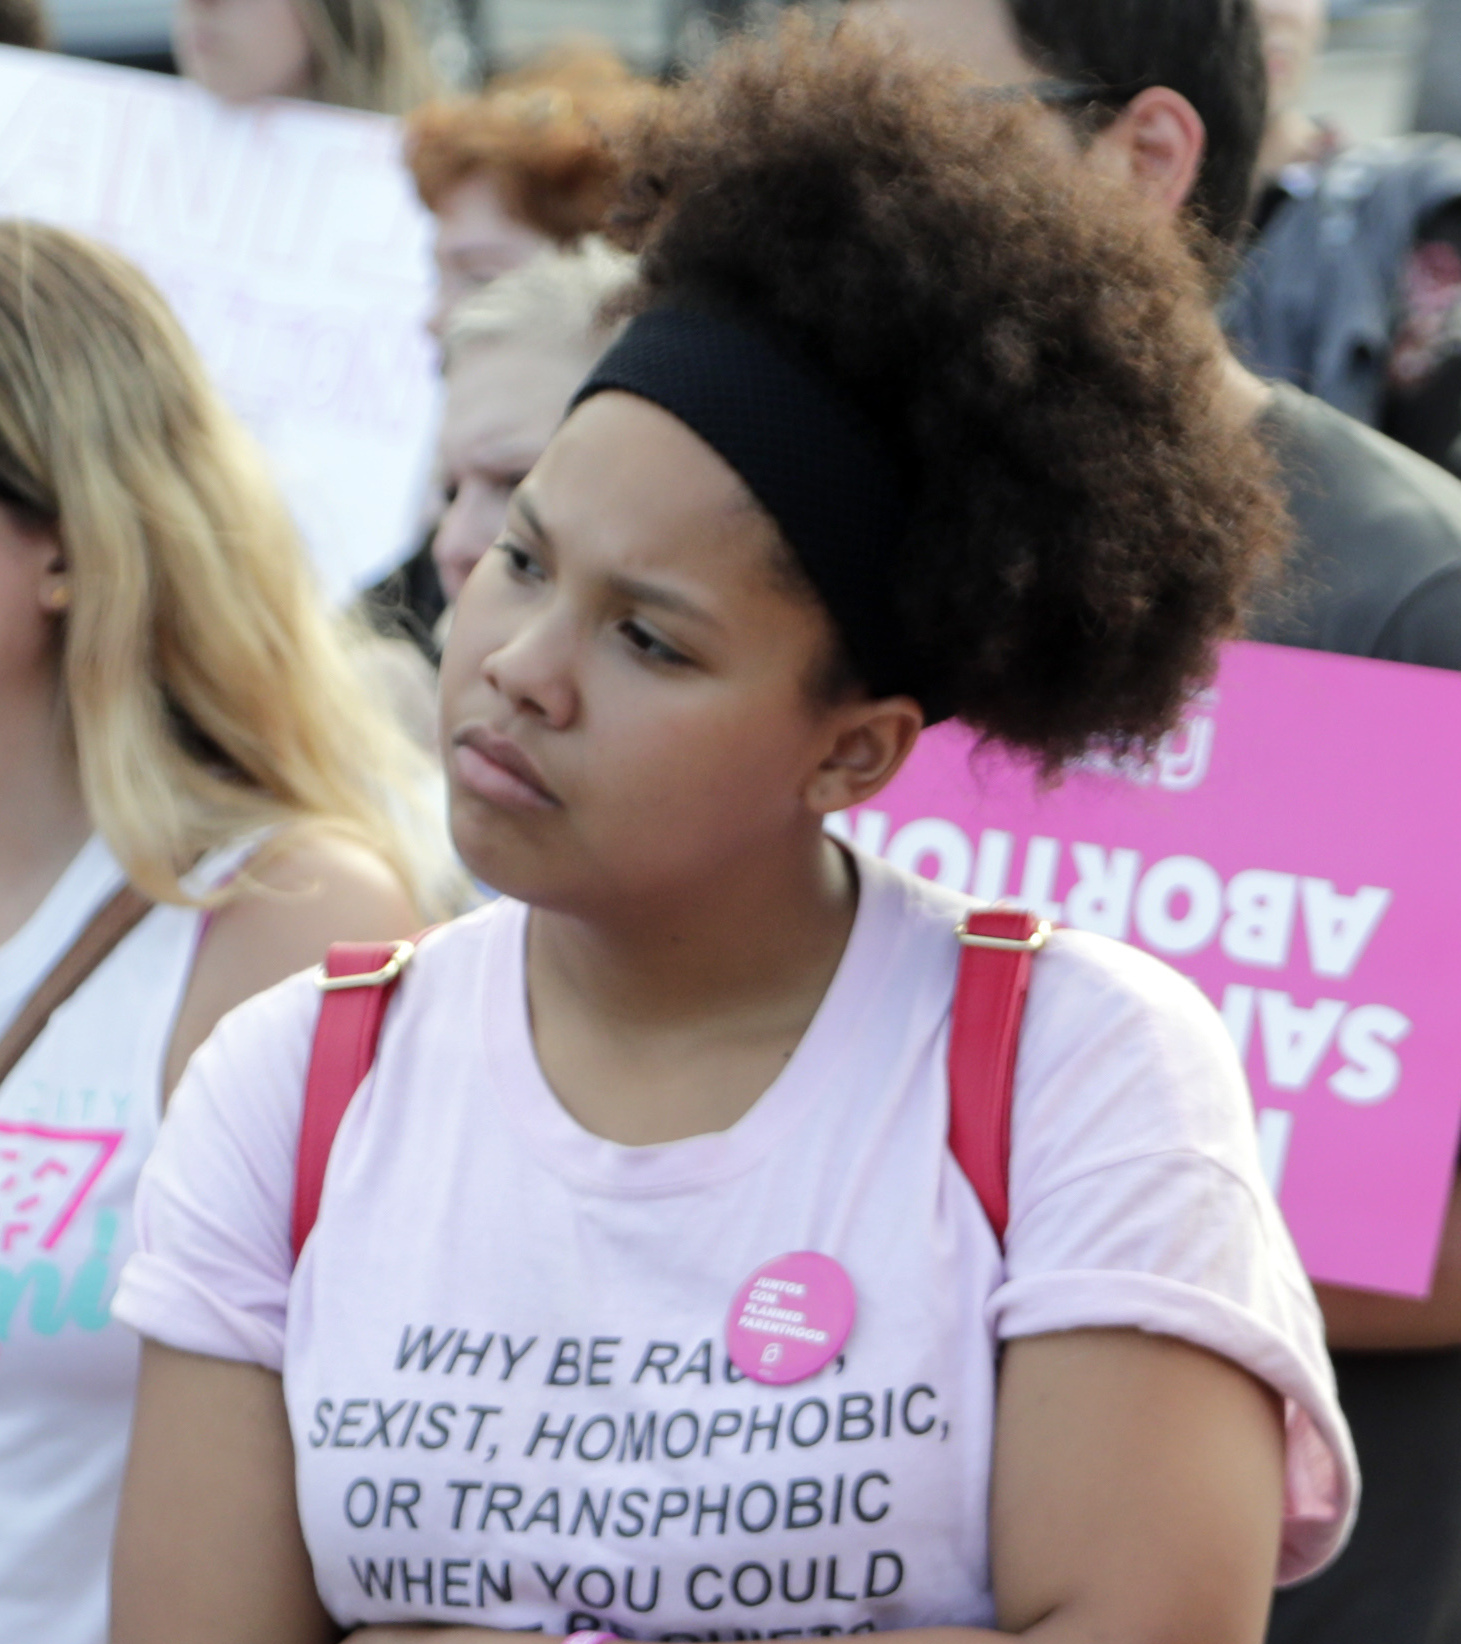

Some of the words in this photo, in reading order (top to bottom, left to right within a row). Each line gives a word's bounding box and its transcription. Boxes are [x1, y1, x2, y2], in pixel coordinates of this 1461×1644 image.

[737, 1314, 829, 1344] PARENTHOOD
[742, 1301, 806, 1323] PLANNED
[394, 1323, 538, 1381] WHY
[544, 1335, 622, 1387] BE
[308, 1396, 504, 1463] SEXIST,
[523, 1383, 951, 1464] HOMOPHOBIC,
[343, 1476, 422, 1530] OR
[446, 1469, 891, 1539] TRANSPHOBIC
[347, 1555, 515, 1609] WHEN
[532, 1560, 661, 1613] YOU
[685, 1550, 905, 1612] COULD
